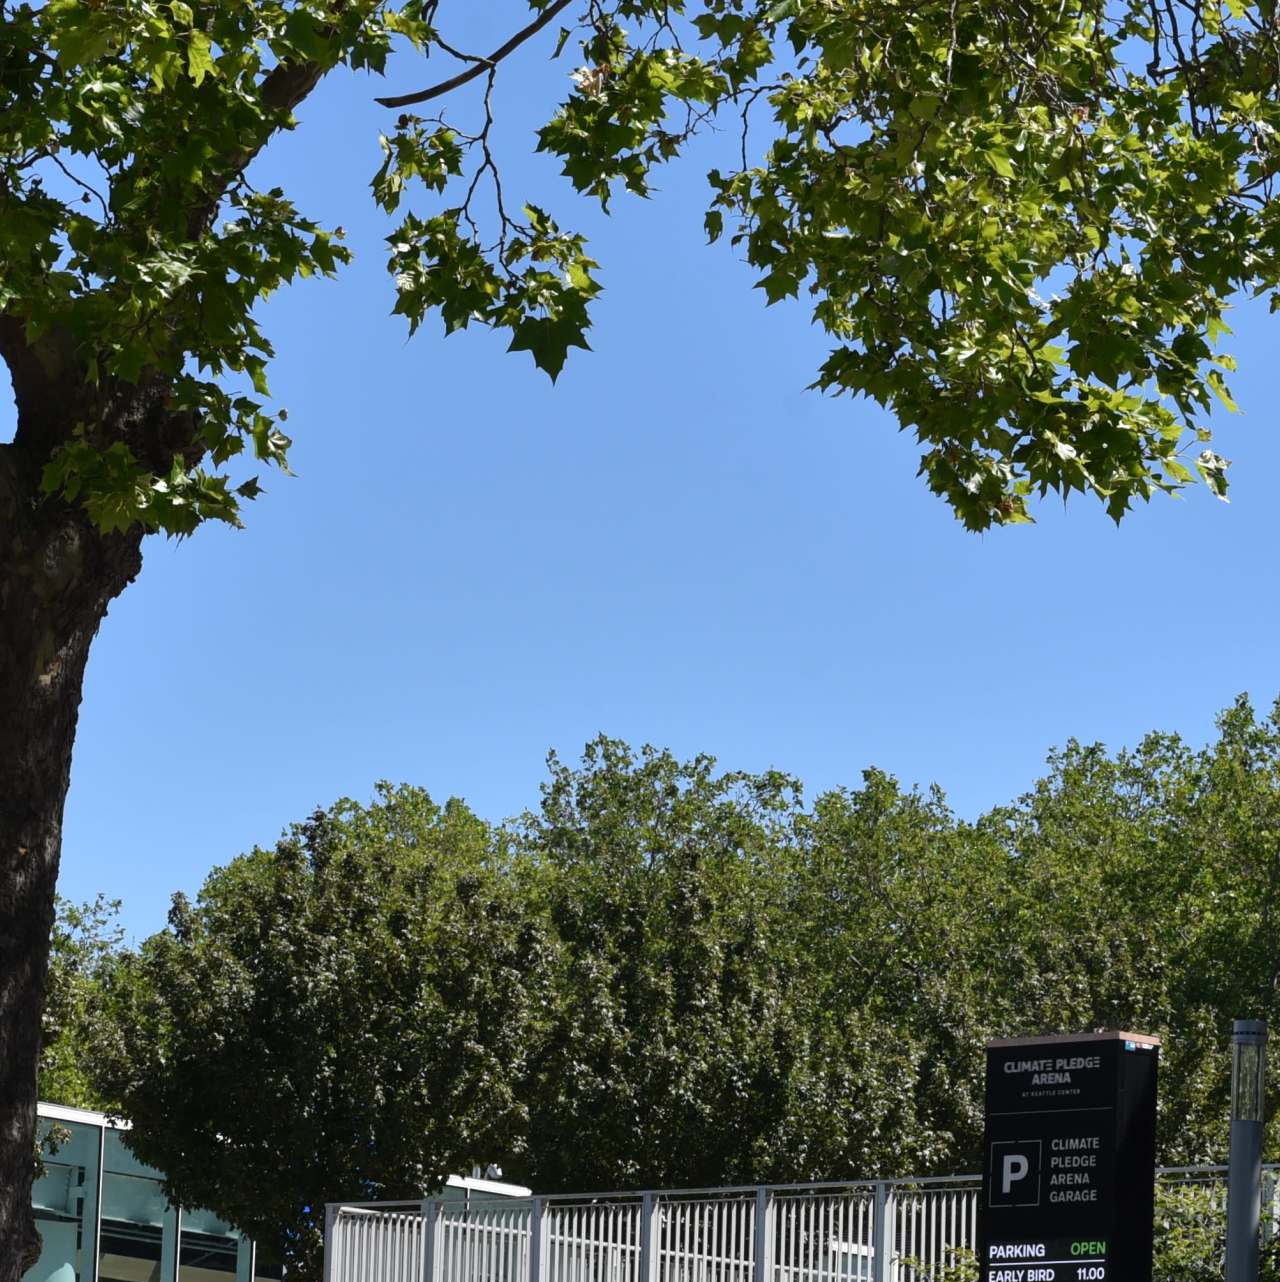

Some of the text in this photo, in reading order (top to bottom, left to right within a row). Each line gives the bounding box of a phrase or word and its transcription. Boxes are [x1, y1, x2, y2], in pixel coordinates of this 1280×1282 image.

[1003, 1056, 1101, 1073] CLIMATE PLEDGE
[1031, 1072, 1072, 1085] ARENA
[1031, 1089, 1056, 1097] SEATTLE
[1057, 1088, 1081, 1096] CENTER
[1051, 1137, 1100, 1151] CLIMATE
[1051, 1155, 1097, 1168] PLEDGE
[1002, 1154, 1029, 1193] P
[1050, 1173, 1090, 1185] ARENA
[1049, 1189, 1098, 1203] GARAGE
[989, 1243, 1046, 1259] PARKING
[1070, 1241, 1106, 1256] OPEN
[1027, 1268, 1055, 1282] BIRD
[1077, 1266, 1105, 1281] 11.00
